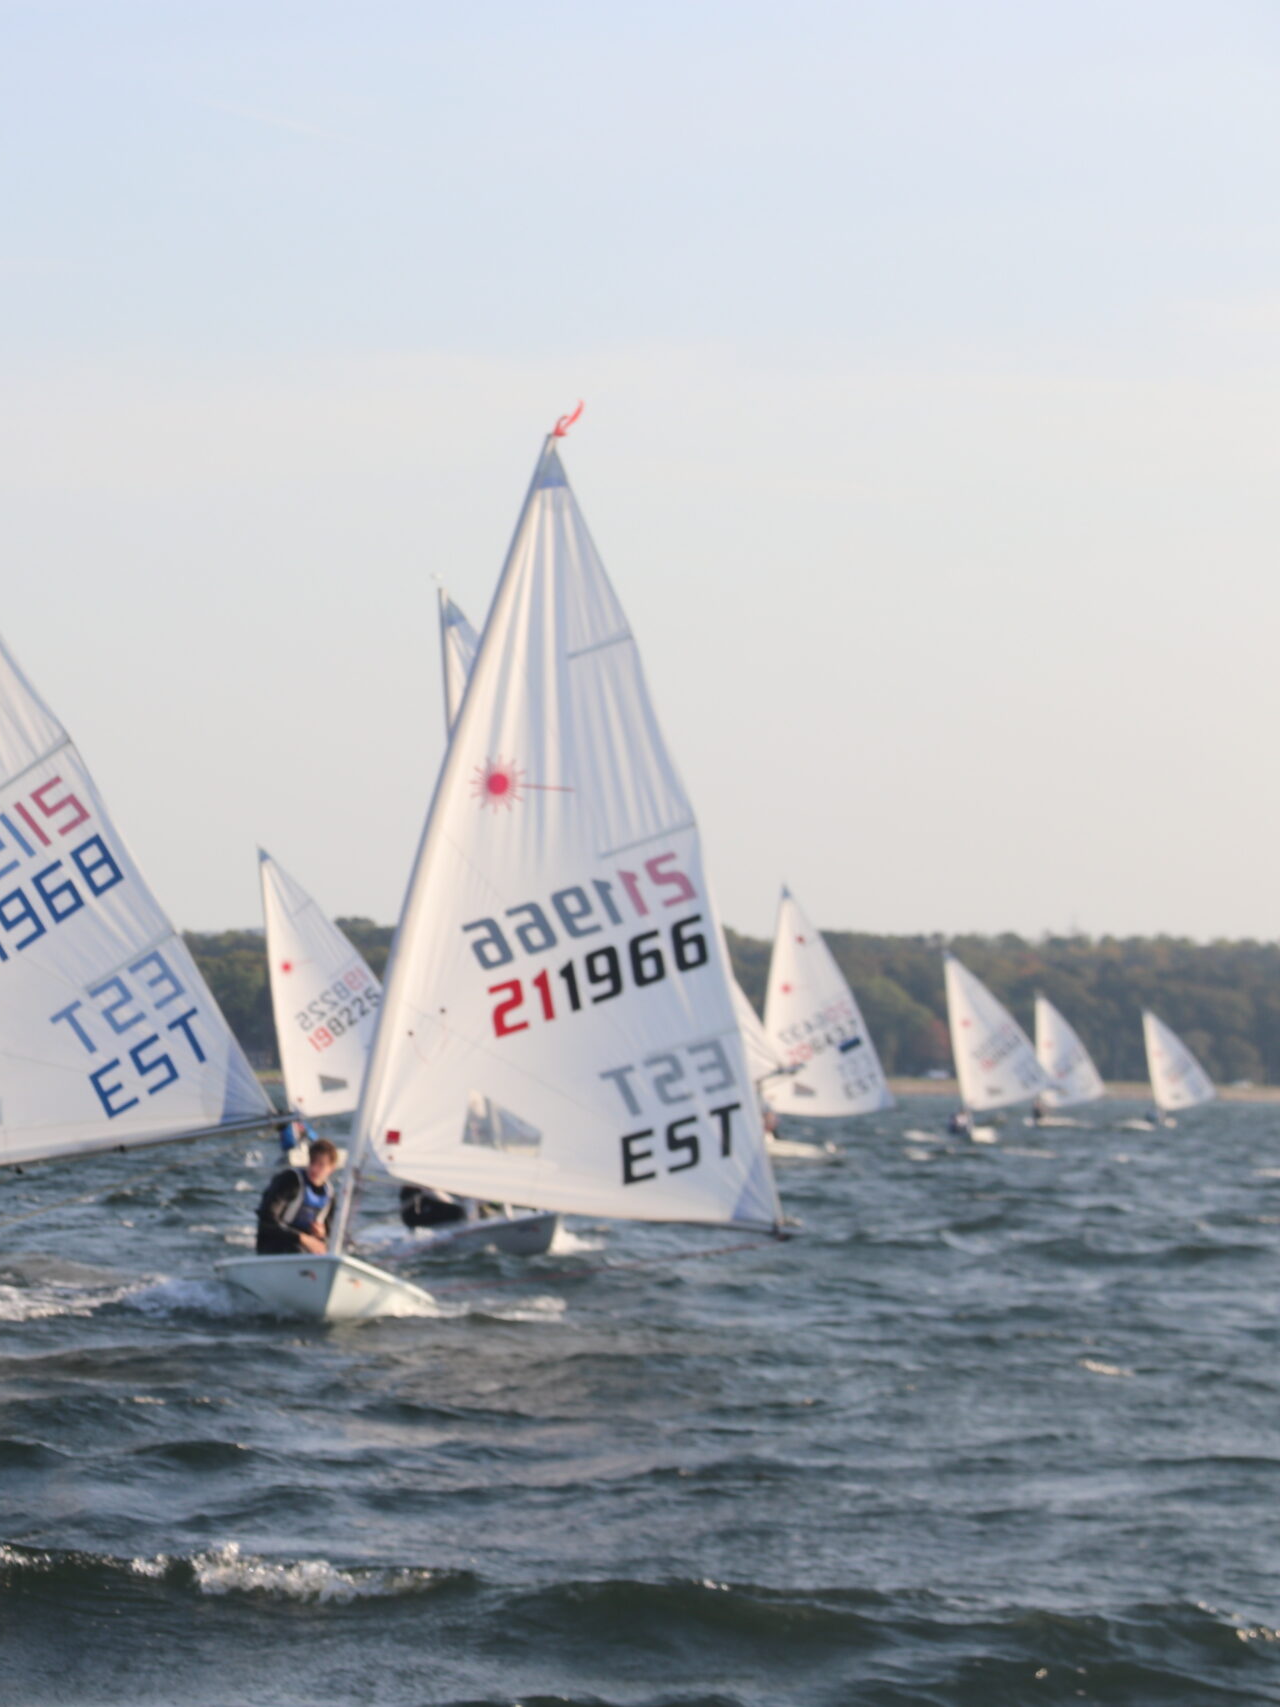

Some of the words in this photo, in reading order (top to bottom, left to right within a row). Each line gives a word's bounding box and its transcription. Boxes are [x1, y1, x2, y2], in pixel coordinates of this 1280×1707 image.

[307, 985, 381, 1053] 198225
[488, 914, 708, 1038] 211966
[88, 1006, 207, 1119] EST
[621, 1102, 742, 1185] EST
